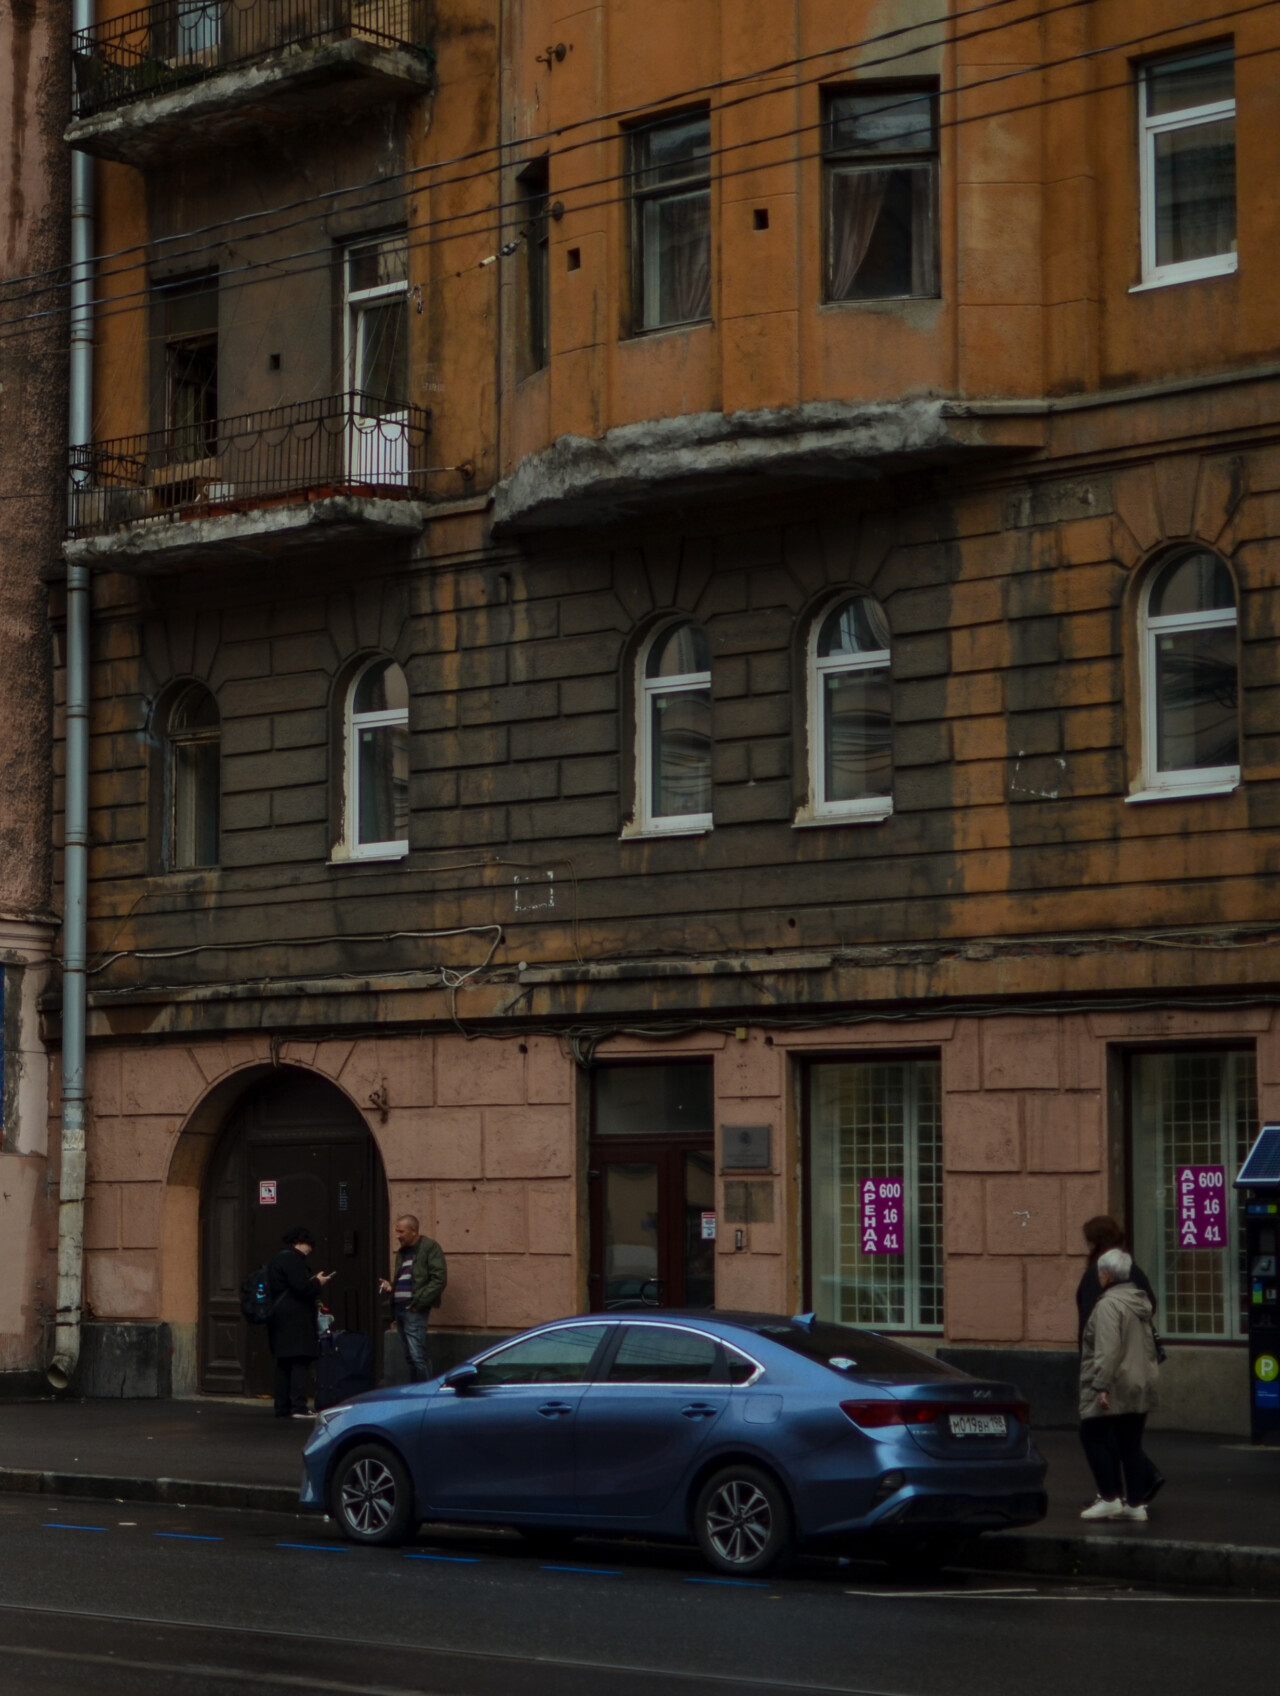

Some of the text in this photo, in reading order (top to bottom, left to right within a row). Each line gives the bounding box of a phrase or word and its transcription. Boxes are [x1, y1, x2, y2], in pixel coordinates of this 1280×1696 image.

[1199, 1172, 1223, 1187] 600
[879, 1183, 900, 1198] 600
[1181, 1169, 1197, 1245] АРЕНДА
[1204, 1198, 1220, 1214] 16
[863, 1181, 877, 1251] АРЕНДА
[883, 1208, 898, 1223] 16
[883, 1233, 899, 1248] 41
[1204, 1225, 1221, 1241] 41
